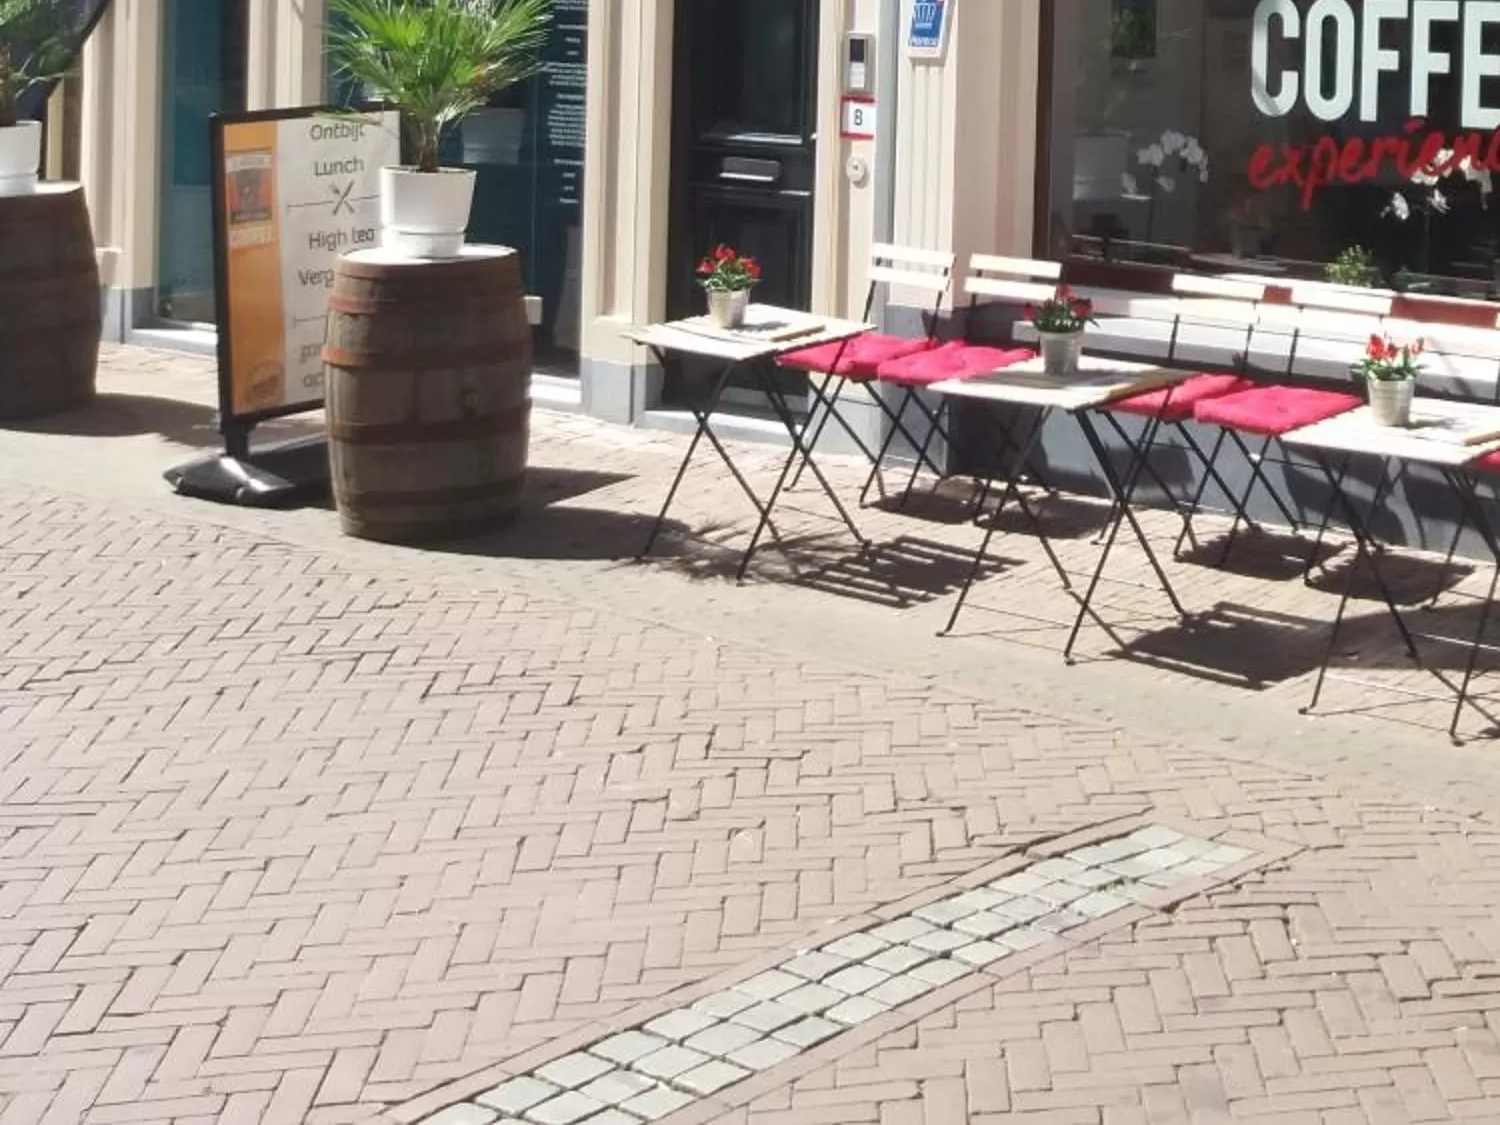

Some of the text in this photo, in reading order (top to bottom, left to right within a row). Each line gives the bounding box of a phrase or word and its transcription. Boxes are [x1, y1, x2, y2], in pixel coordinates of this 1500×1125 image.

[314, 155, 365, 176] Lunch
[308, 227, 376, 252] High tea
